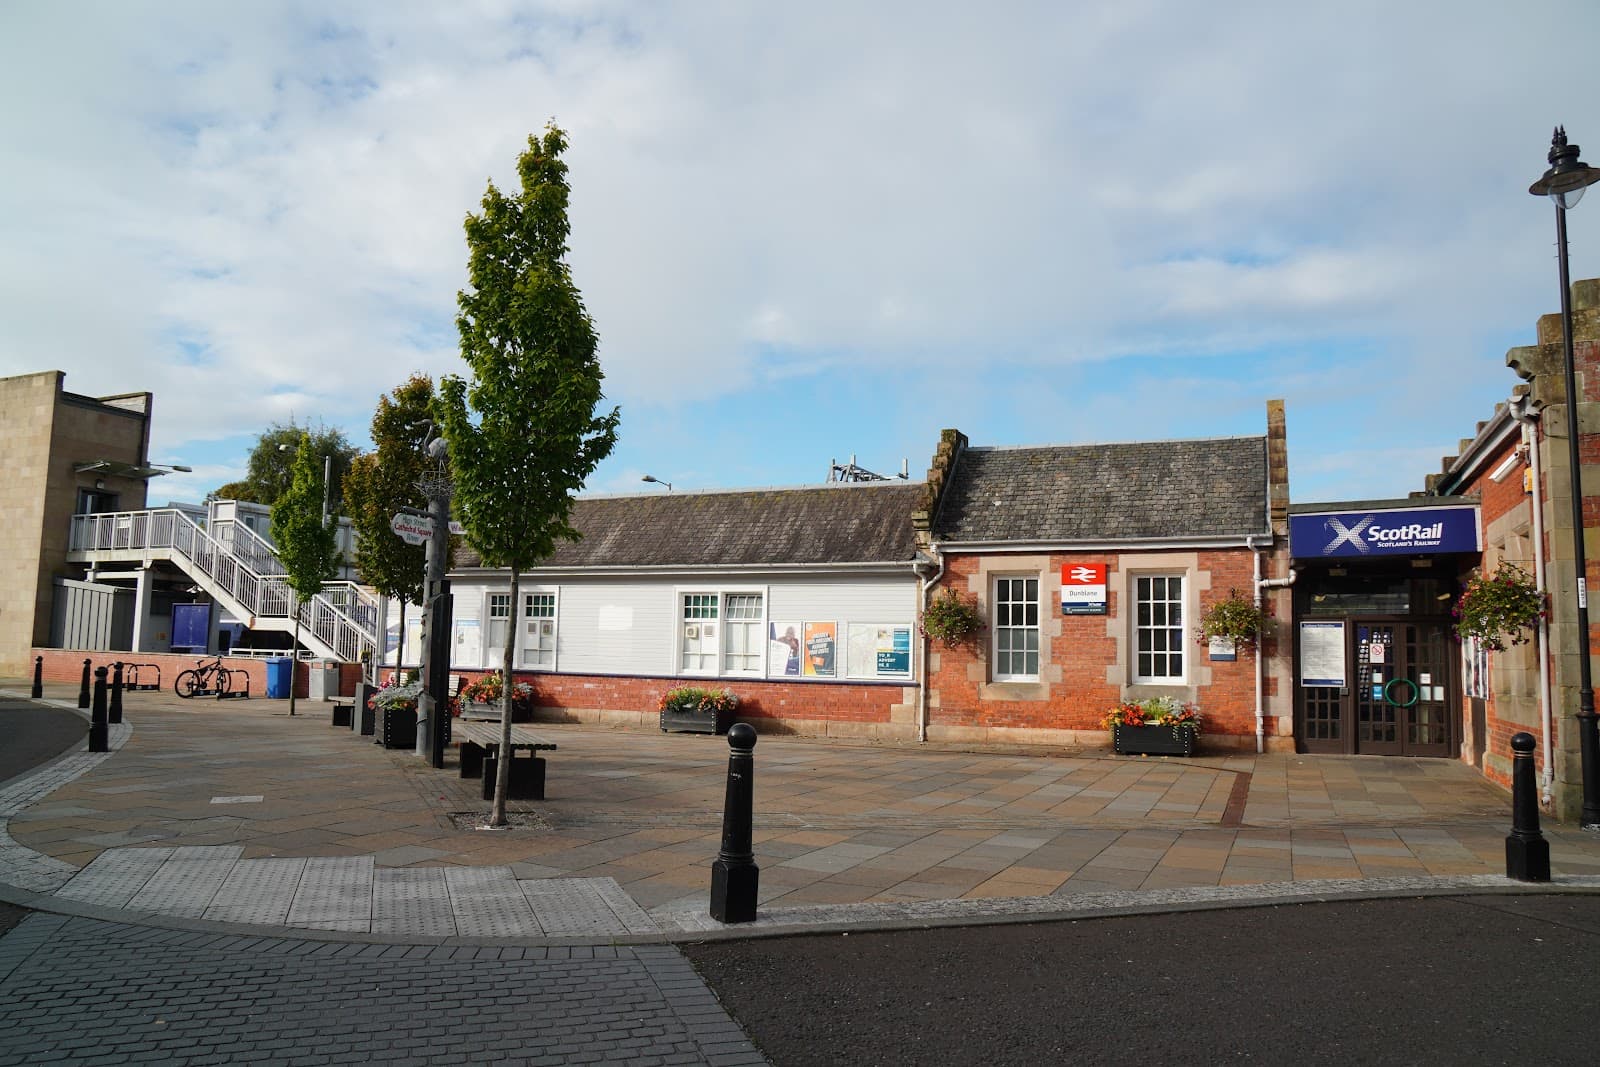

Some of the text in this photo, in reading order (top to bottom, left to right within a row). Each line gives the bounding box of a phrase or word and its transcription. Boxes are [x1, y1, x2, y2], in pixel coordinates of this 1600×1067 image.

[394, 523, 432, 537] Cathedral Square
[413, 518, 427, 528] Street
[1368, 522, 1443, 541] ScotRail
